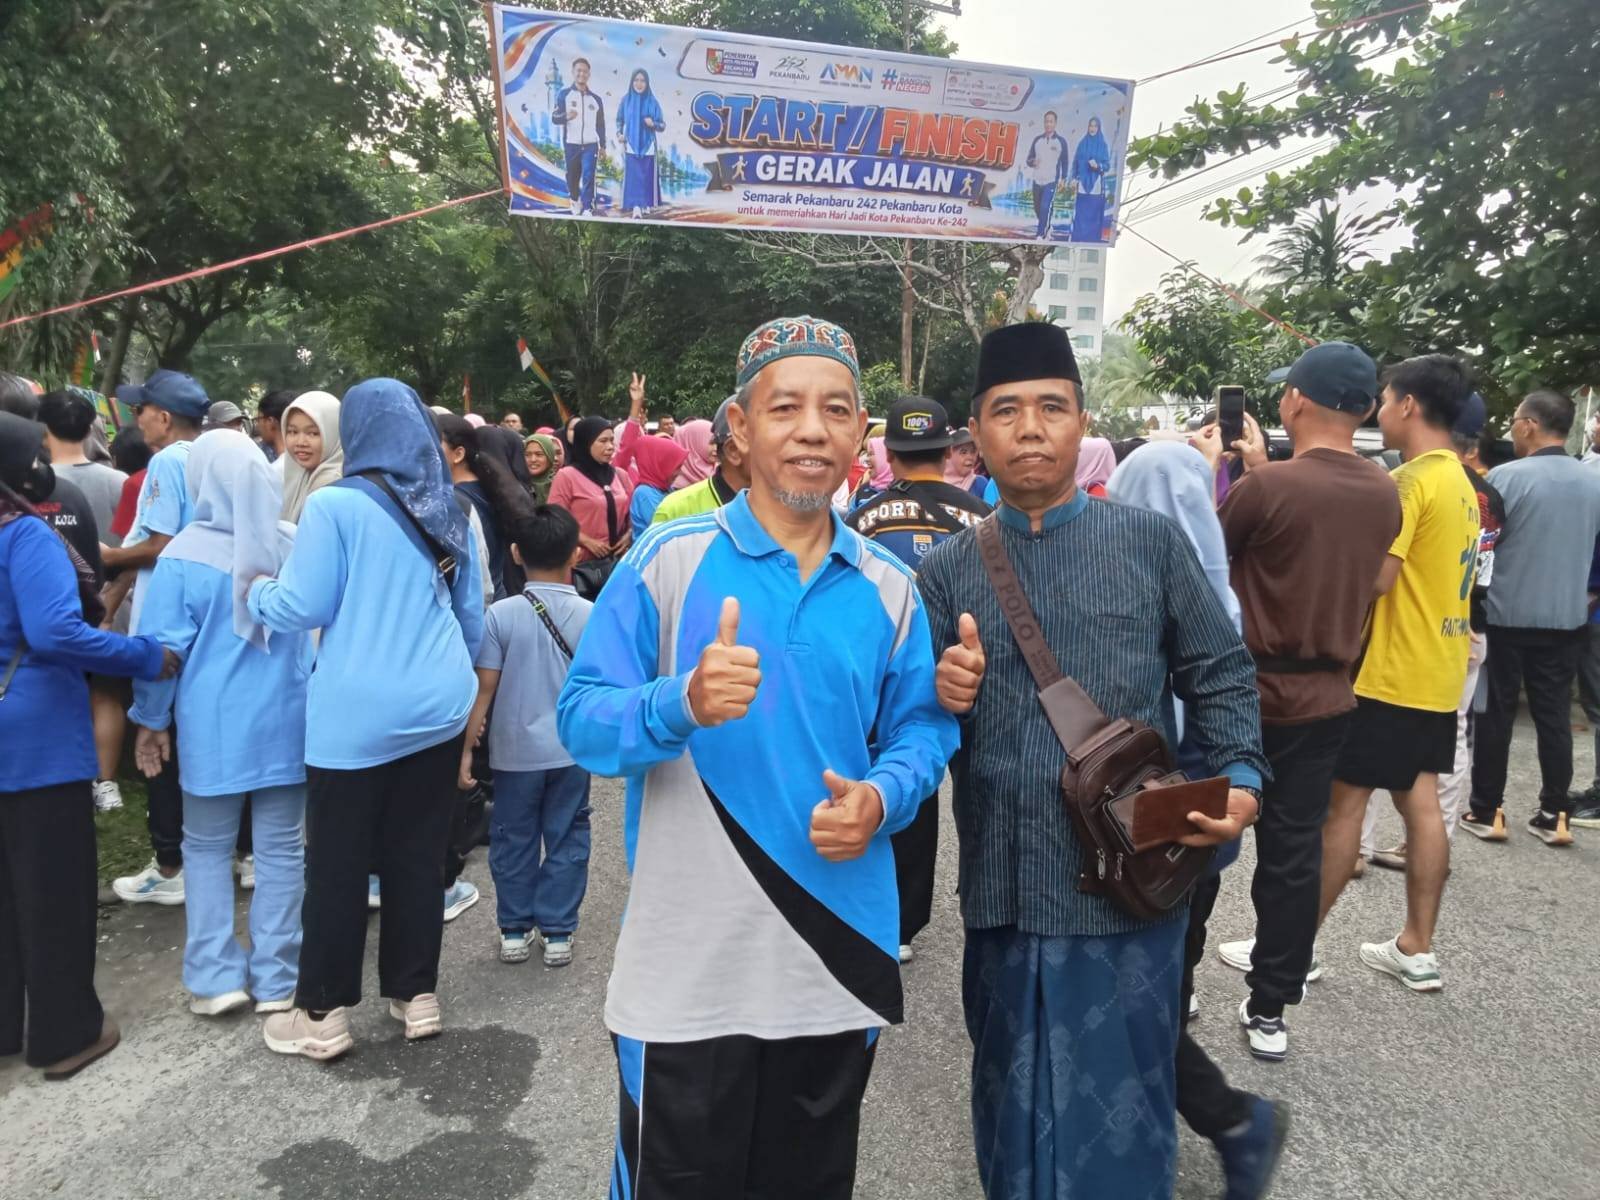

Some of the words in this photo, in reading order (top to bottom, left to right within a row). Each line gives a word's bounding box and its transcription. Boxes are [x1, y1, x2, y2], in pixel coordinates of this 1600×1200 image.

[769, 71, 810, 81] PEKANBARU
[820, 63, 873, 83] AMAN
[896, 82, 931, 94] NEGERI
[689, 91, 847, 150] START
[878, 106, 1020, 167] FINISH
[756, 154, 858, 184] GERAK
[863, 161, 954, 193] JALAN
[742, 190, 793, 205] Semarak
[795, 193, 855, 208] Pekanbaru
[856, 197, 878, 210] 242
[879, 199, 937, 213] Pekanbaru
[937, 203, 963, 215] Kota
[737, 206, 765, 216] untuk
[766, 207, 828, 219] memeriahkan
[828, 210, 848, 221] Hari
[848, 211, 868, 221] Jadi
[868, 212, 889, 223] Kota
[889, 213, 936, 226] Pekanbaru
[936, 217, 969, 228] Ke-242
[907, 416, 929, 430] 100%
[54, 514, 77, 525] KOTA
[857, 499, 921, 532] SPORT
[999, 583, 1036, 642] POLO
